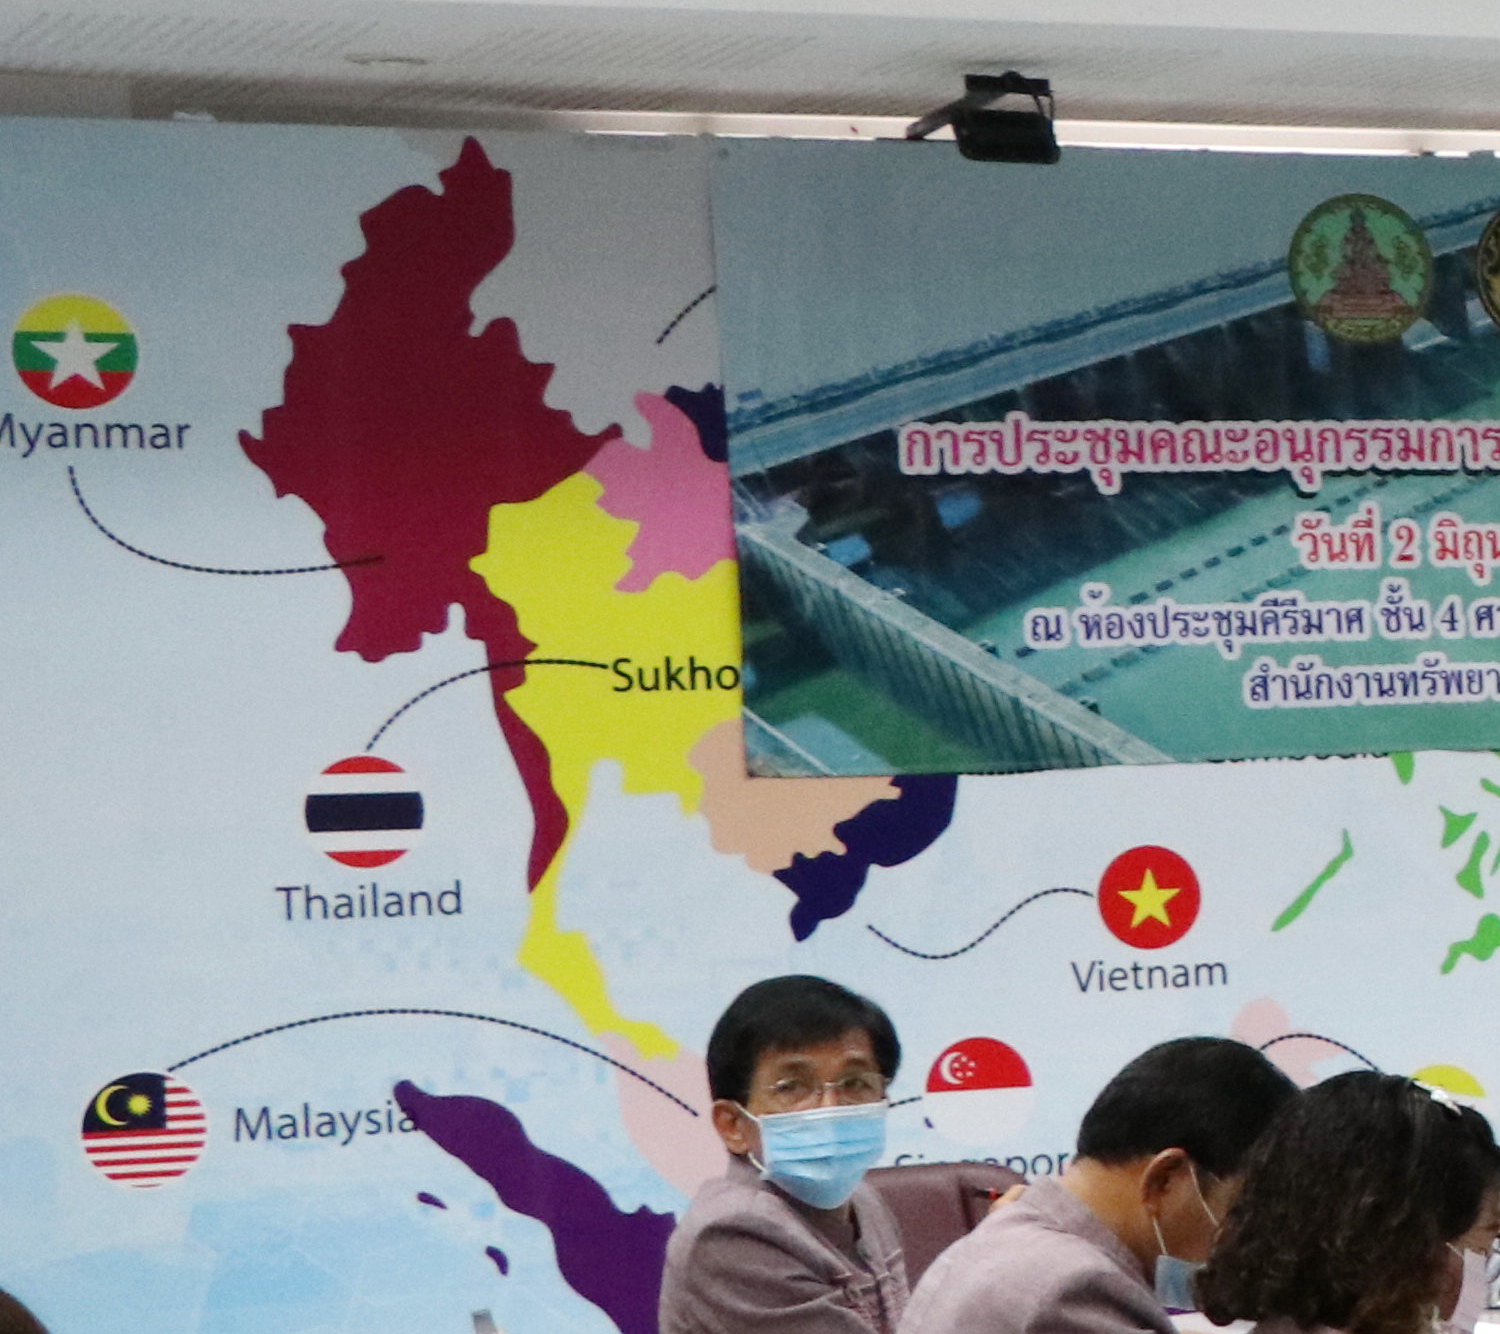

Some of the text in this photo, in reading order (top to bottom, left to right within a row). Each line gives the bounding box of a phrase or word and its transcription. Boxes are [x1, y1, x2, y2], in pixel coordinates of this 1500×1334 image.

[1300, 509, 1376, 565] วันที่
[1396, 525, 1414, 561] 2
[1032, 607, 1062, 641] ณ
[1382, 581, 1426, 633] ชั้น
[1442, 603, 1460, 633] 4
[612, 656, 740, 692] Sukho
[275, 880, 463, 922] Thailand
[1071, 960, 1228, 993] Vietnam
